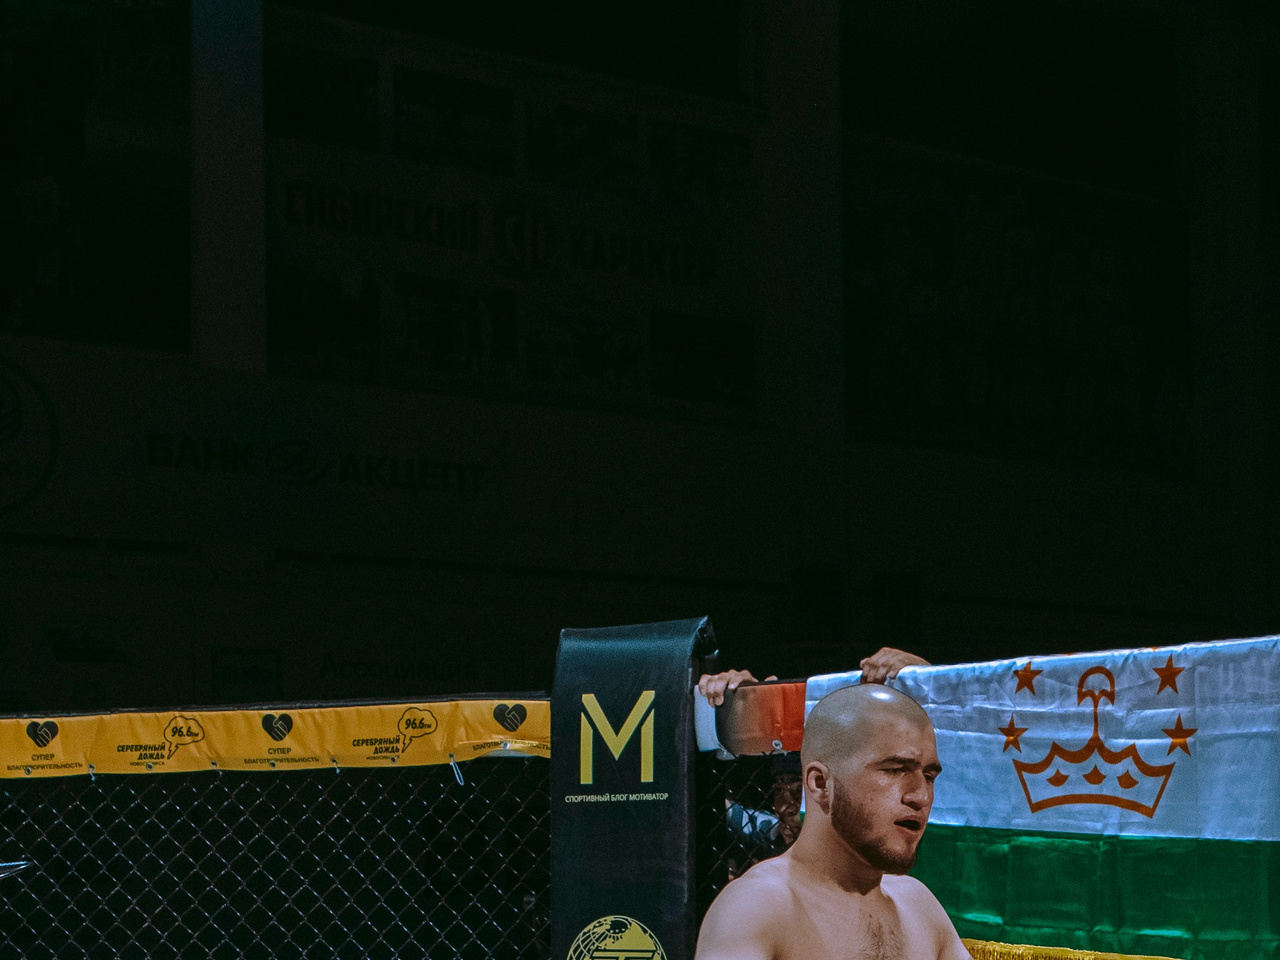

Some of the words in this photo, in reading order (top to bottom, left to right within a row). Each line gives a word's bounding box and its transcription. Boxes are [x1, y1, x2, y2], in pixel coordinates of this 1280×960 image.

[146, 432, 256, 474] БАНК
[338, 452, 486, 495] АКЦЕПТ
[267, 747, 291, 755] СУПЕР
[31, 753, 55, 761] СУПЕР
[564, 793, 610, 803] СПОРТИВНЫЙ
[611, 794, 628, 802] БЛОГ
[629, 792, 669, 801] МОТИВАТОР
